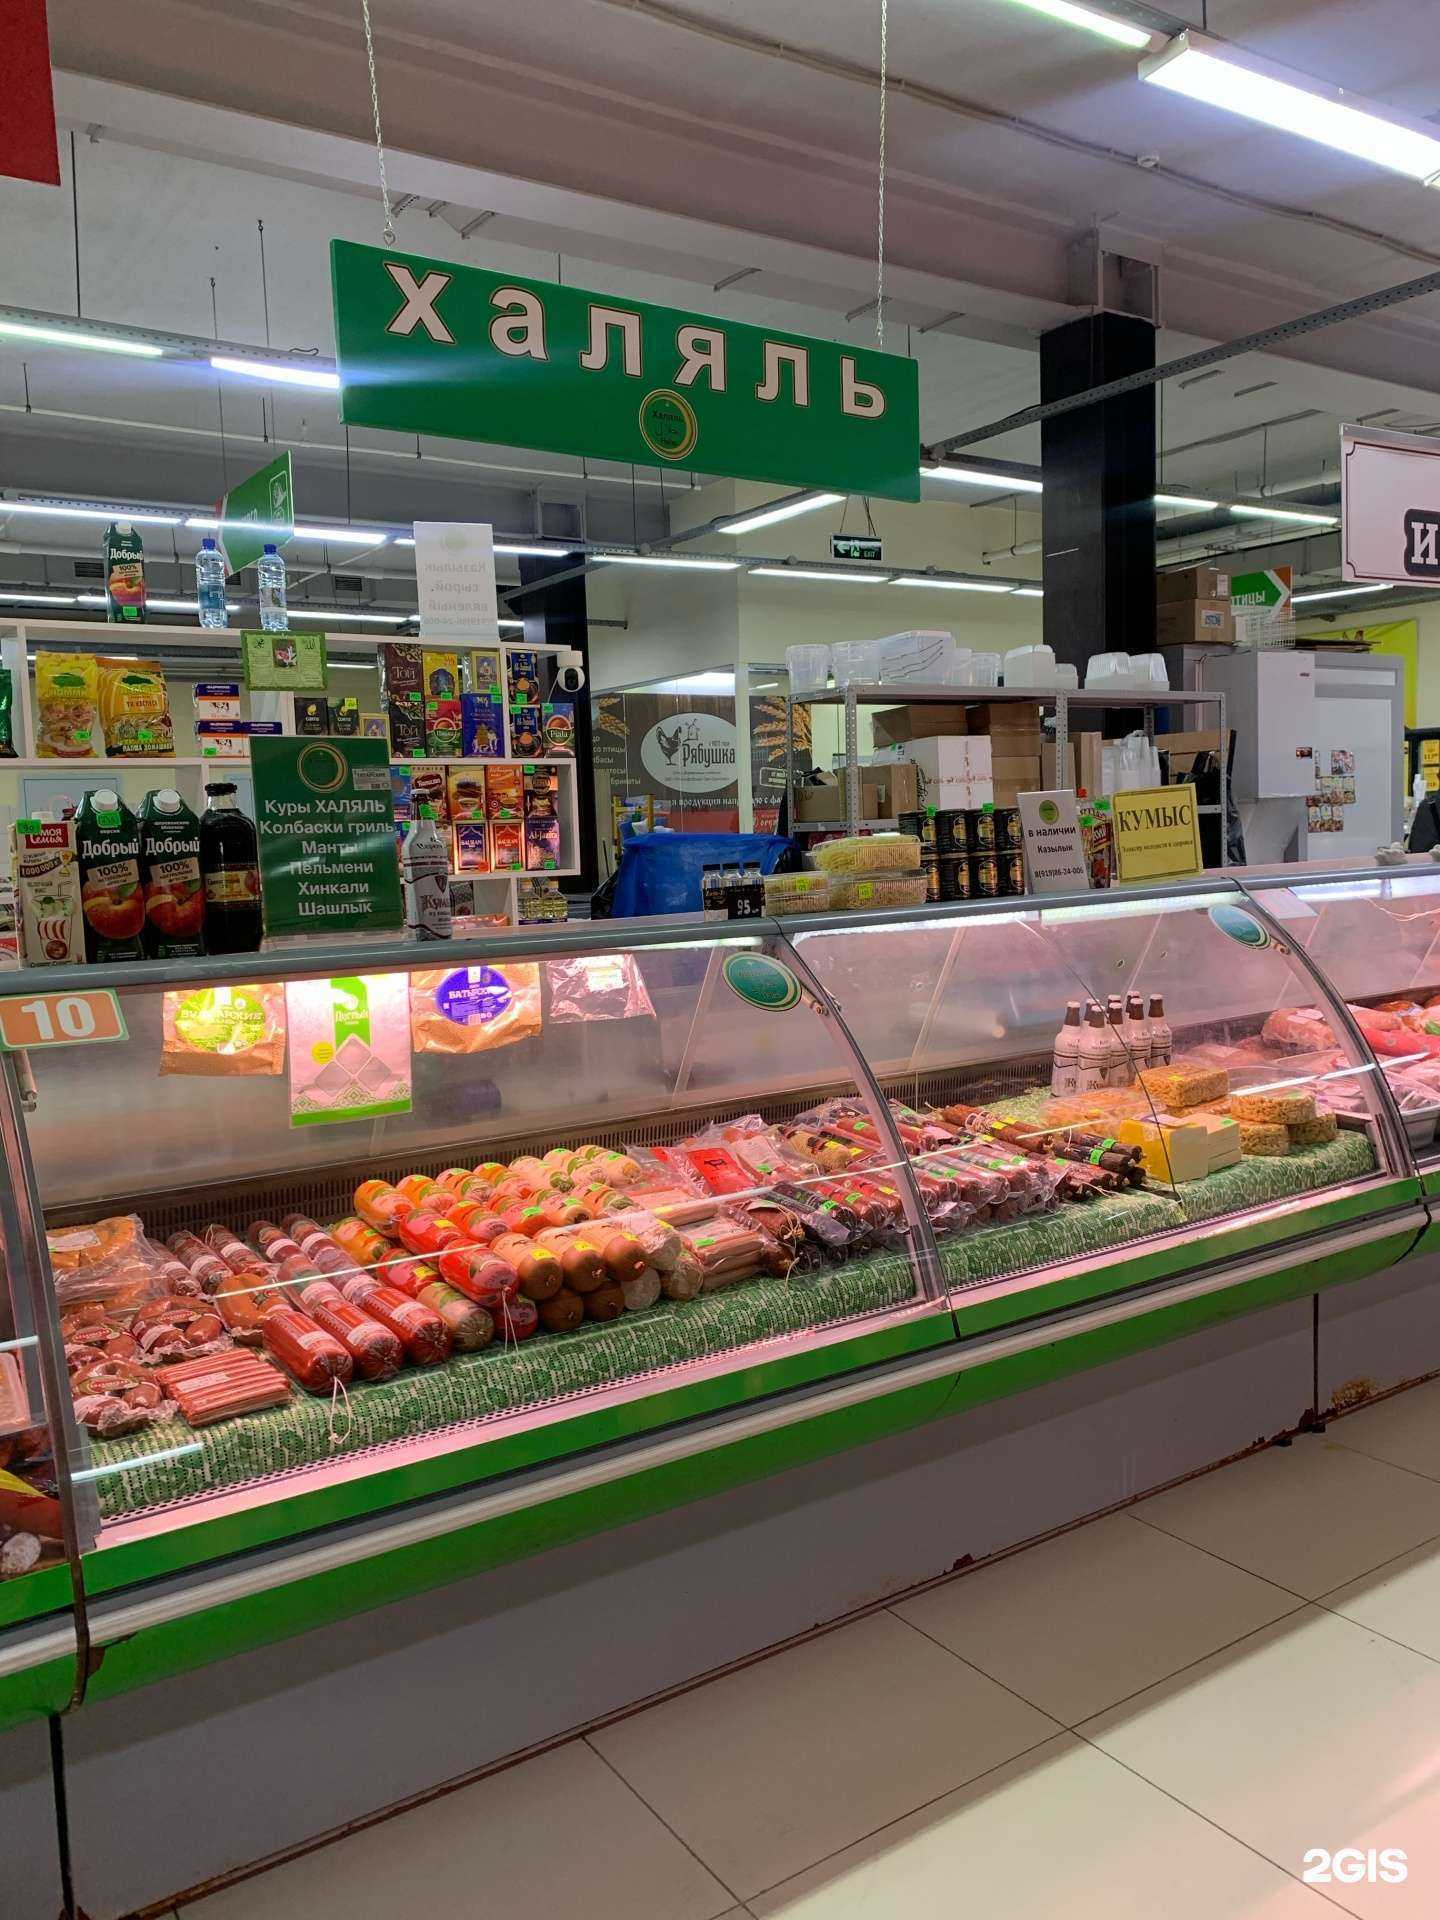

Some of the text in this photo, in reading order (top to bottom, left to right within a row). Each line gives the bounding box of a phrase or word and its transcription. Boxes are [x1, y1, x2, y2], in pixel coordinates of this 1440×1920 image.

[682, 743, 735, 768] Рябушка
[265, 800, 387, 816] Куры ХАЛЯЛЬ
[1118, 804, 1192, 833] КУМЫС
[260, 821, 397, 835] Колбаски гриль
[1036, 826, 1076, 837] наличии
[82, 838, 139, 859] Добрый
[145, 837, 201, 857] Добрый
[302, 841, 361, 854] Манты
[97, 863, 129, 877] 100%
[160, 861, 190, 874] 100%
[289, 862, 374, 875] Пельмени
[298, 882, 369, 896] Хинкали
[298, 902, 372, 916] Шашлык
[21, 998, 96, 1041] 10
